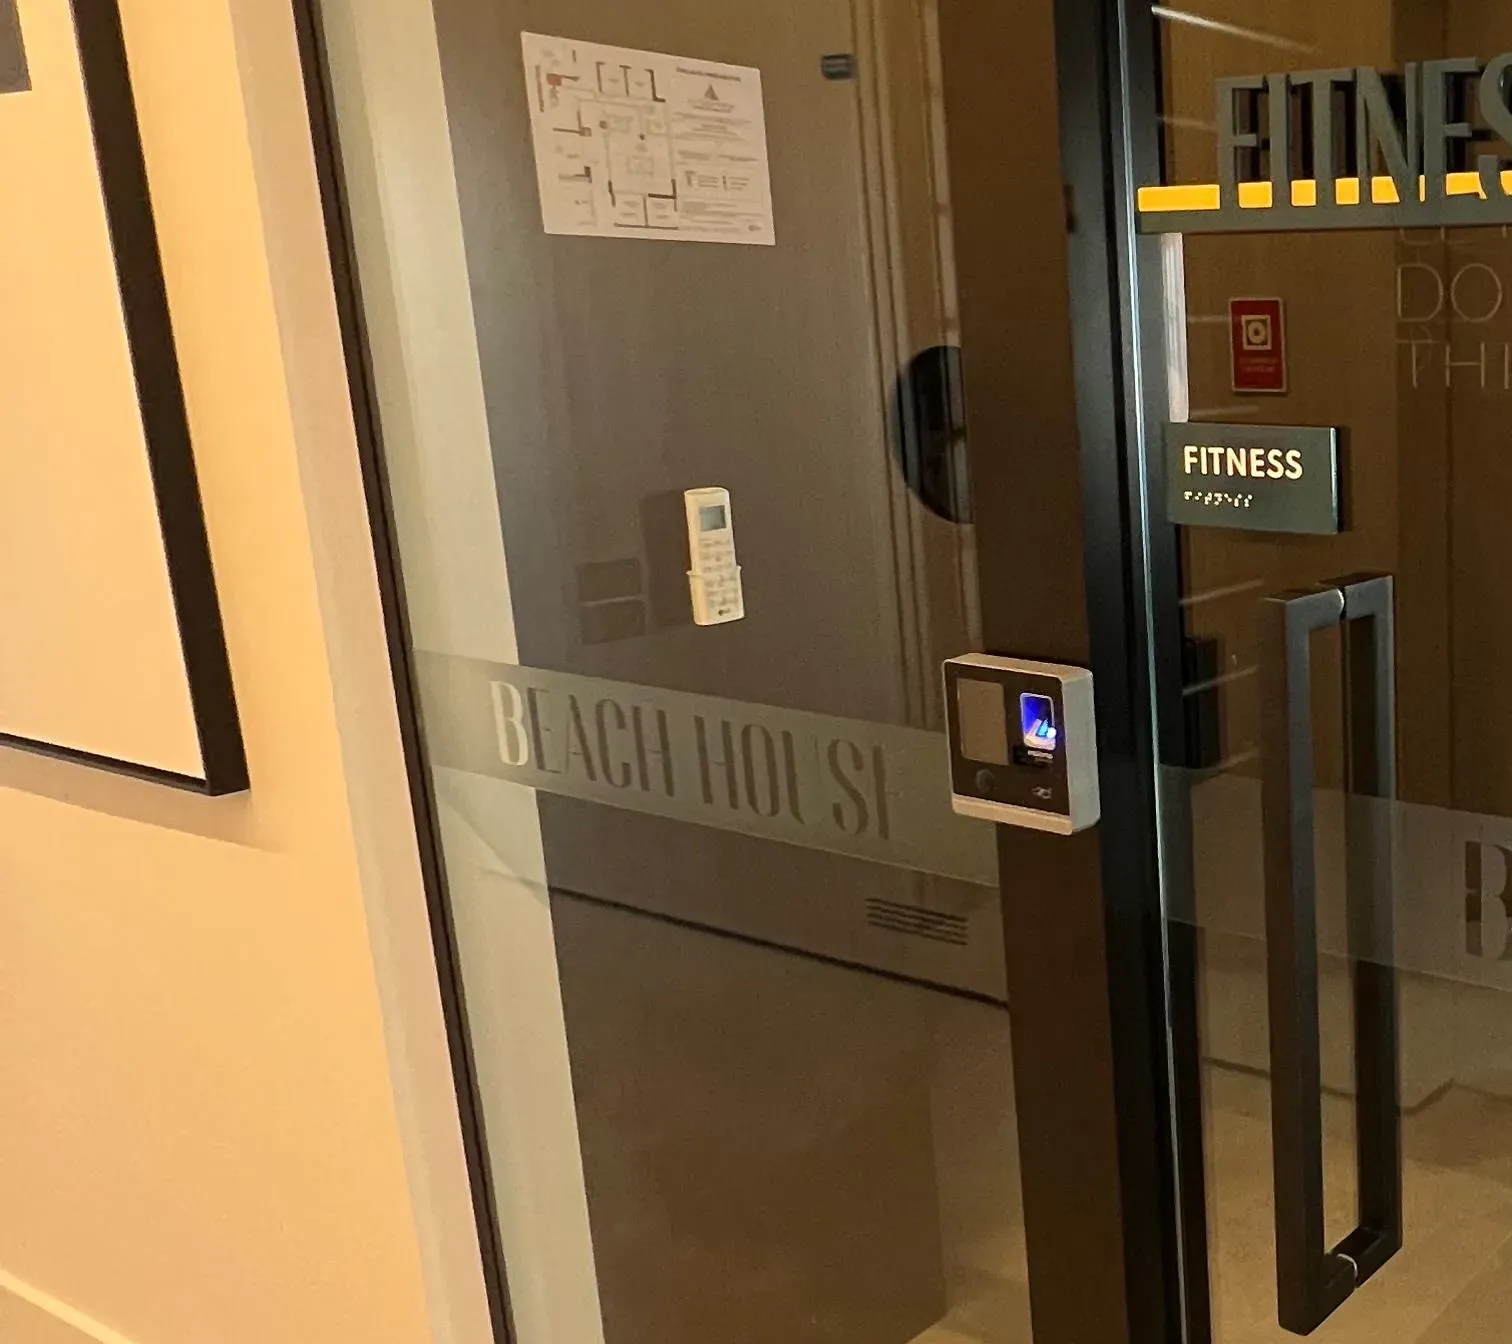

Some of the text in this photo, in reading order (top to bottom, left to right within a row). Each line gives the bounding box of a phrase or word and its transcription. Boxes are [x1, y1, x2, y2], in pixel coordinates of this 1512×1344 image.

[1397, 262, 1503, 323] DO
[1183, 445, 1304, 480] FITNESS
[489, 680, 675, 798] BEACH
